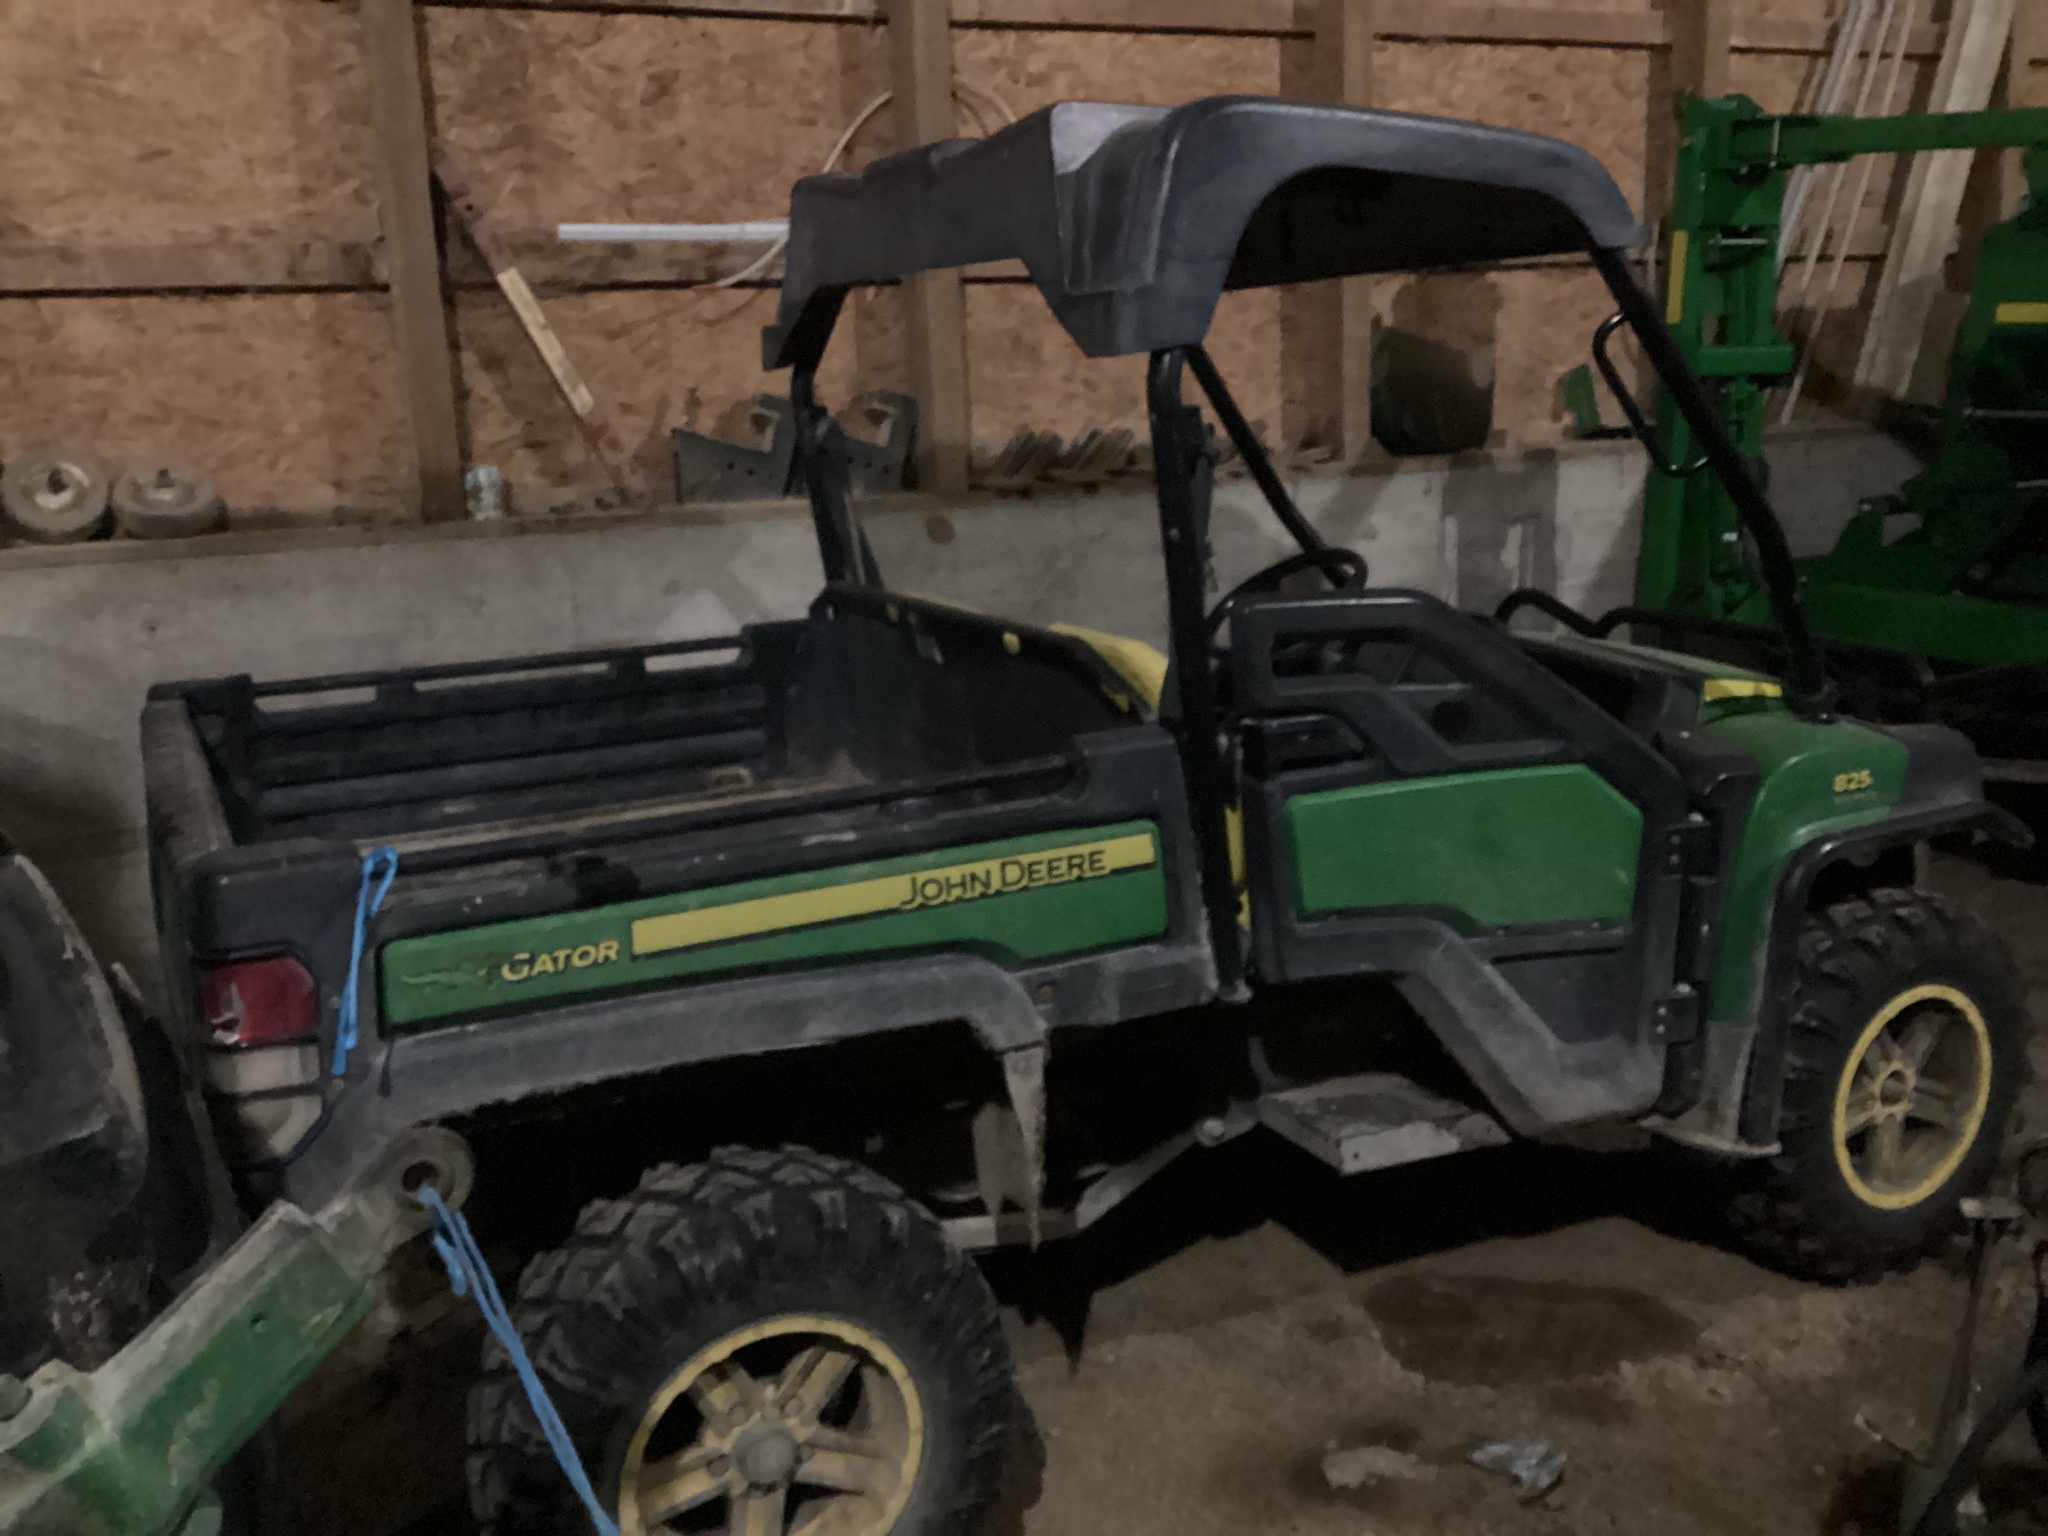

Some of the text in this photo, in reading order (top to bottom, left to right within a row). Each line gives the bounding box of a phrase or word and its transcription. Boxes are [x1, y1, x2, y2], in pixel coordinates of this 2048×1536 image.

[901, 850, 1106, 906] JOHN DEERE
[500, 939, 620, 981] GATOR
